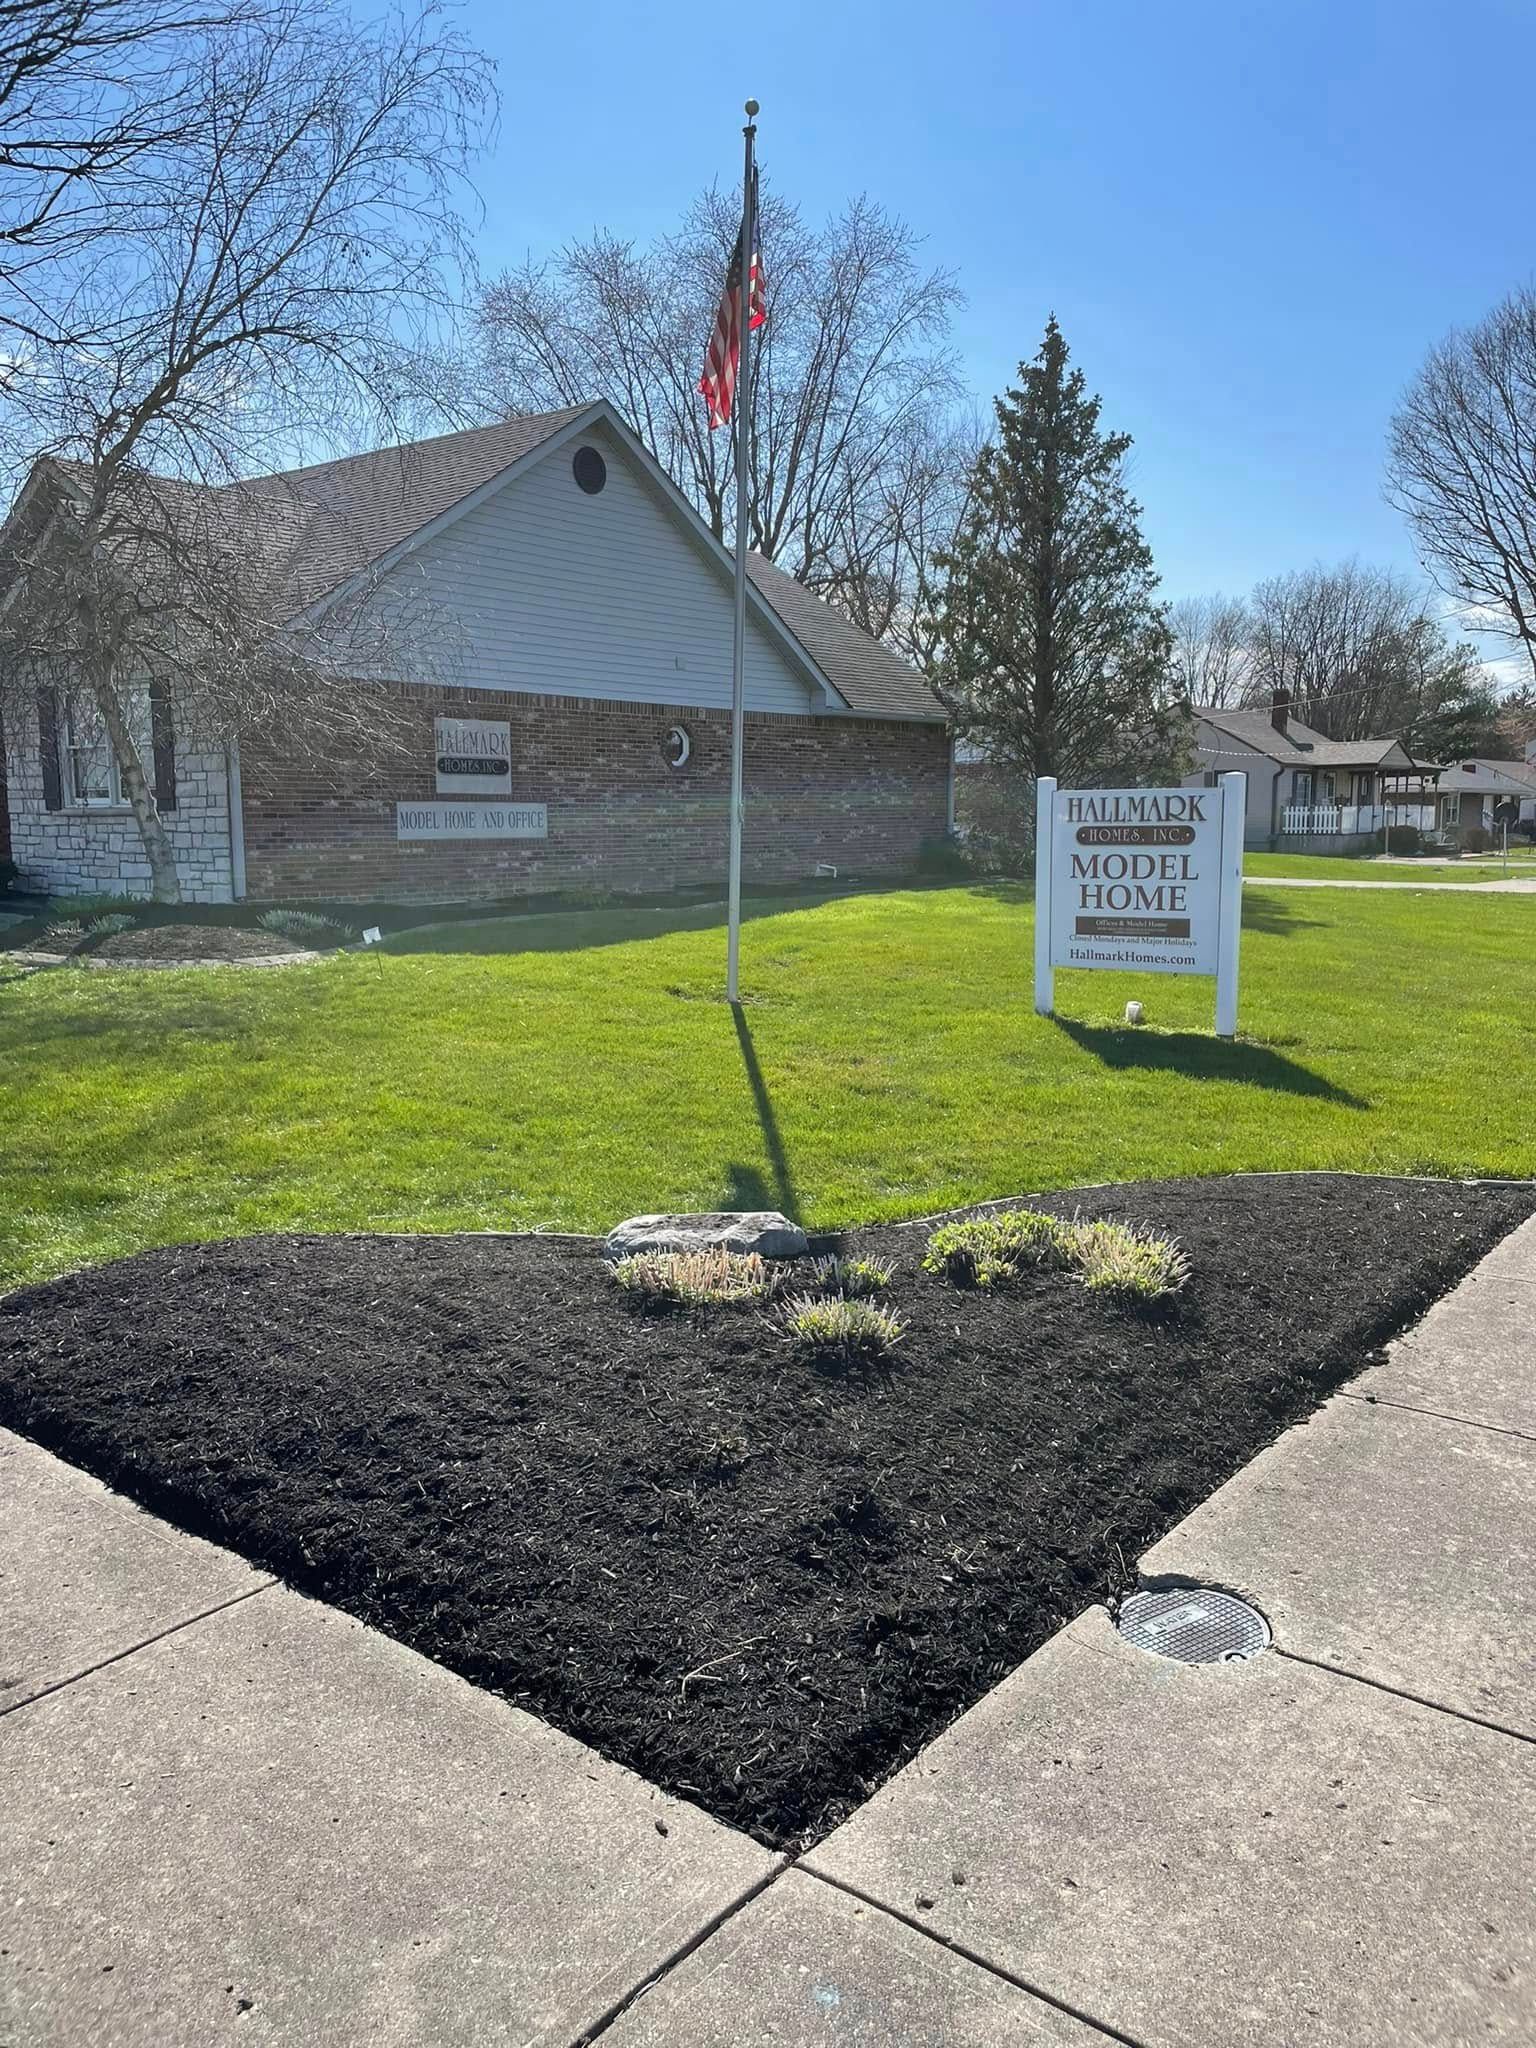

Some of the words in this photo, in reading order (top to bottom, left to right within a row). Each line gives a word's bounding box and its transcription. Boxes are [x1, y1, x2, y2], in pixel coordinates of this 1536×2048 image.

[436, 729, 508, 755] HALLMARK
[1067, 795, 1206, 822] HALLMARK
[400, 811, 440, 829] MODEL
[444, 811, 475, 829] HOME
[482, 811, 504, 829] AND
[508, 811, 544, 828] OFFICE
[1089, 828, 1145, 842] HOMES,
[1153, 828, 1185, 842] INC.
[1070, 854, 1199, 880] MODEL
[1079, 884, 1187, 911] HOME
[1127, 920, 1147, 928] Model
[1069, 934, 1092, 942] Closed
[1094, 935, 1126, 945] Mondays
[1126, 936, 1140, 944] and
[1142, 937, 1163, 947] Major
[1164, 939, 1197, 948] Holidays
[1070, 949, 1195, 965] HallmarkHomes.com
[1153, 1610, 1192, 1628] WATER
